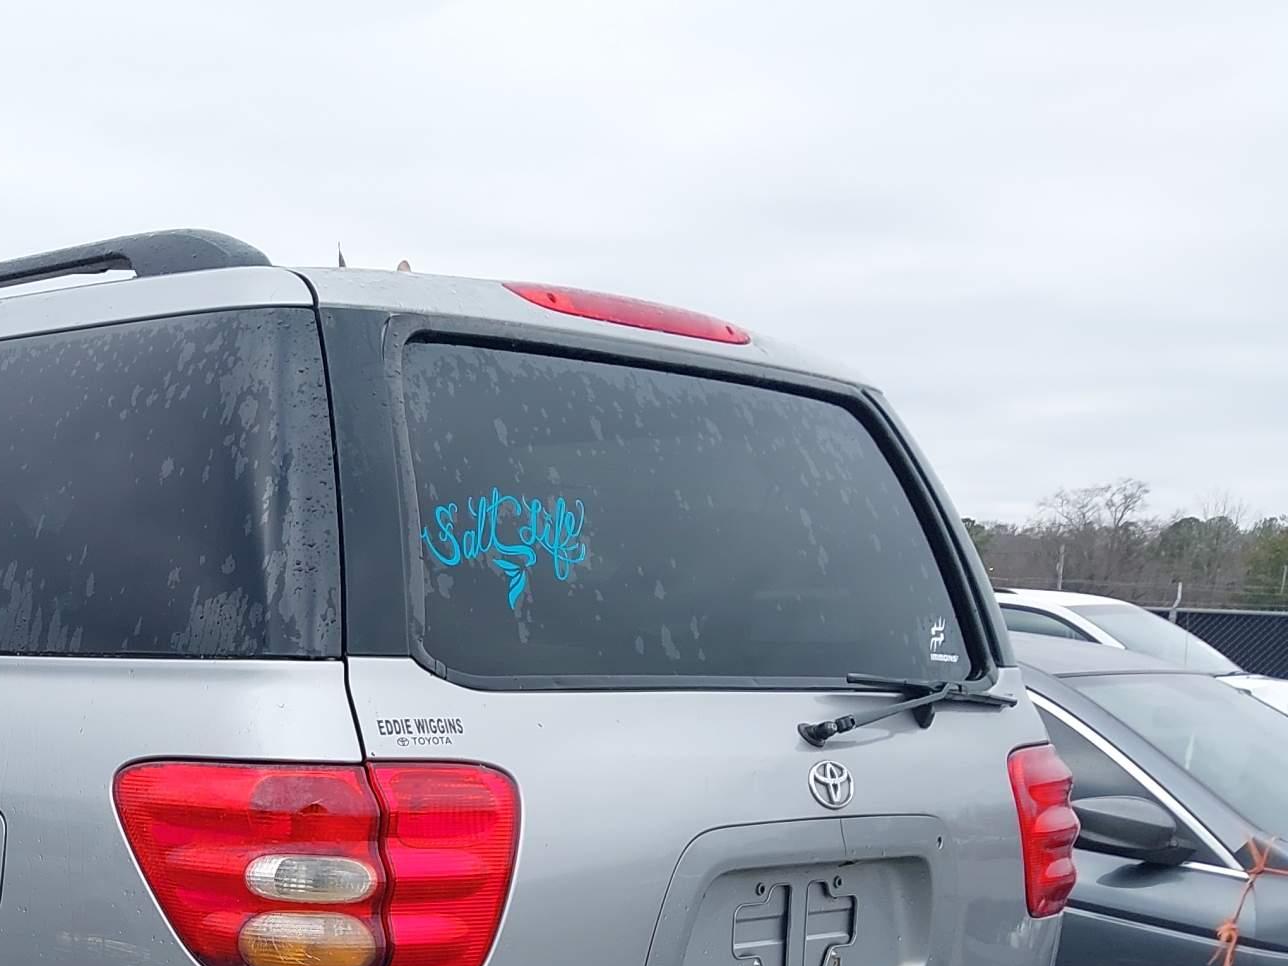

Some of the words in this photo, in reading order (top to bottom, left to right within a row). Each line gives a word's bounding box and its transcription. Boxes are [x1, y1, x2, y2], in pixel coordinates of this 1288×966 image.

[420, 487, 521, 566] Salt
[519, 496, 585, 580] Life
[376, 719, 413, 735] EDDIE
[413, 718, 464, 734] WIGGINS
[411, 736, 452, 745] TOYOTA
